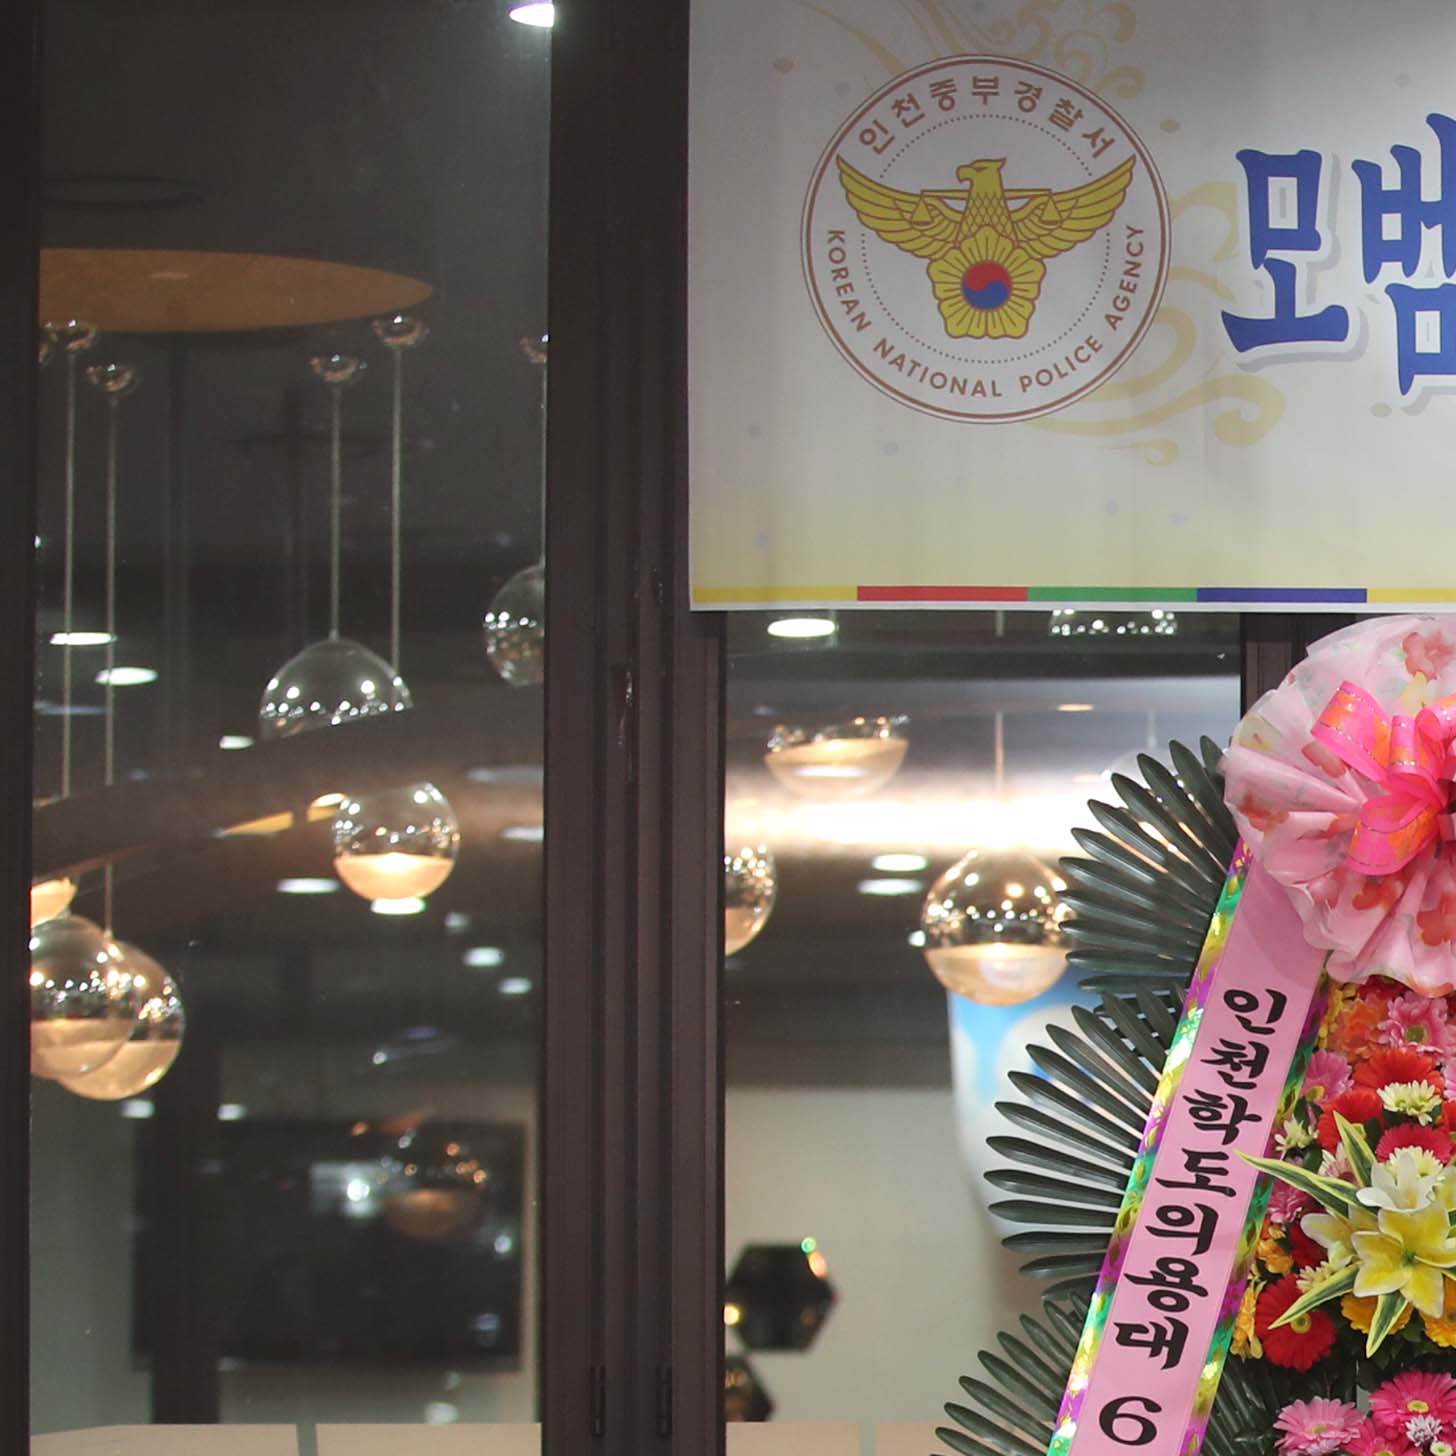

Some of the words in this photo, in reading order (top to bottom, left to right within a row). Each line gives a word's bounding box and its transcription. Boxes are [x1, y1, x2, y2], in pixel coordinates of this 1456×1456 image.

[859, 75, 1115, 158] 인천중부경찰서
[827, 228, 872, 333] KOREAN
[873, 338, 1003, 397] NATIONAL
[1019, 335, 1103, 392] POLICE
[1104, 225, 1145, 331] AGENCY
[1113, 988, 1288, 1370] 인천학도의용대
